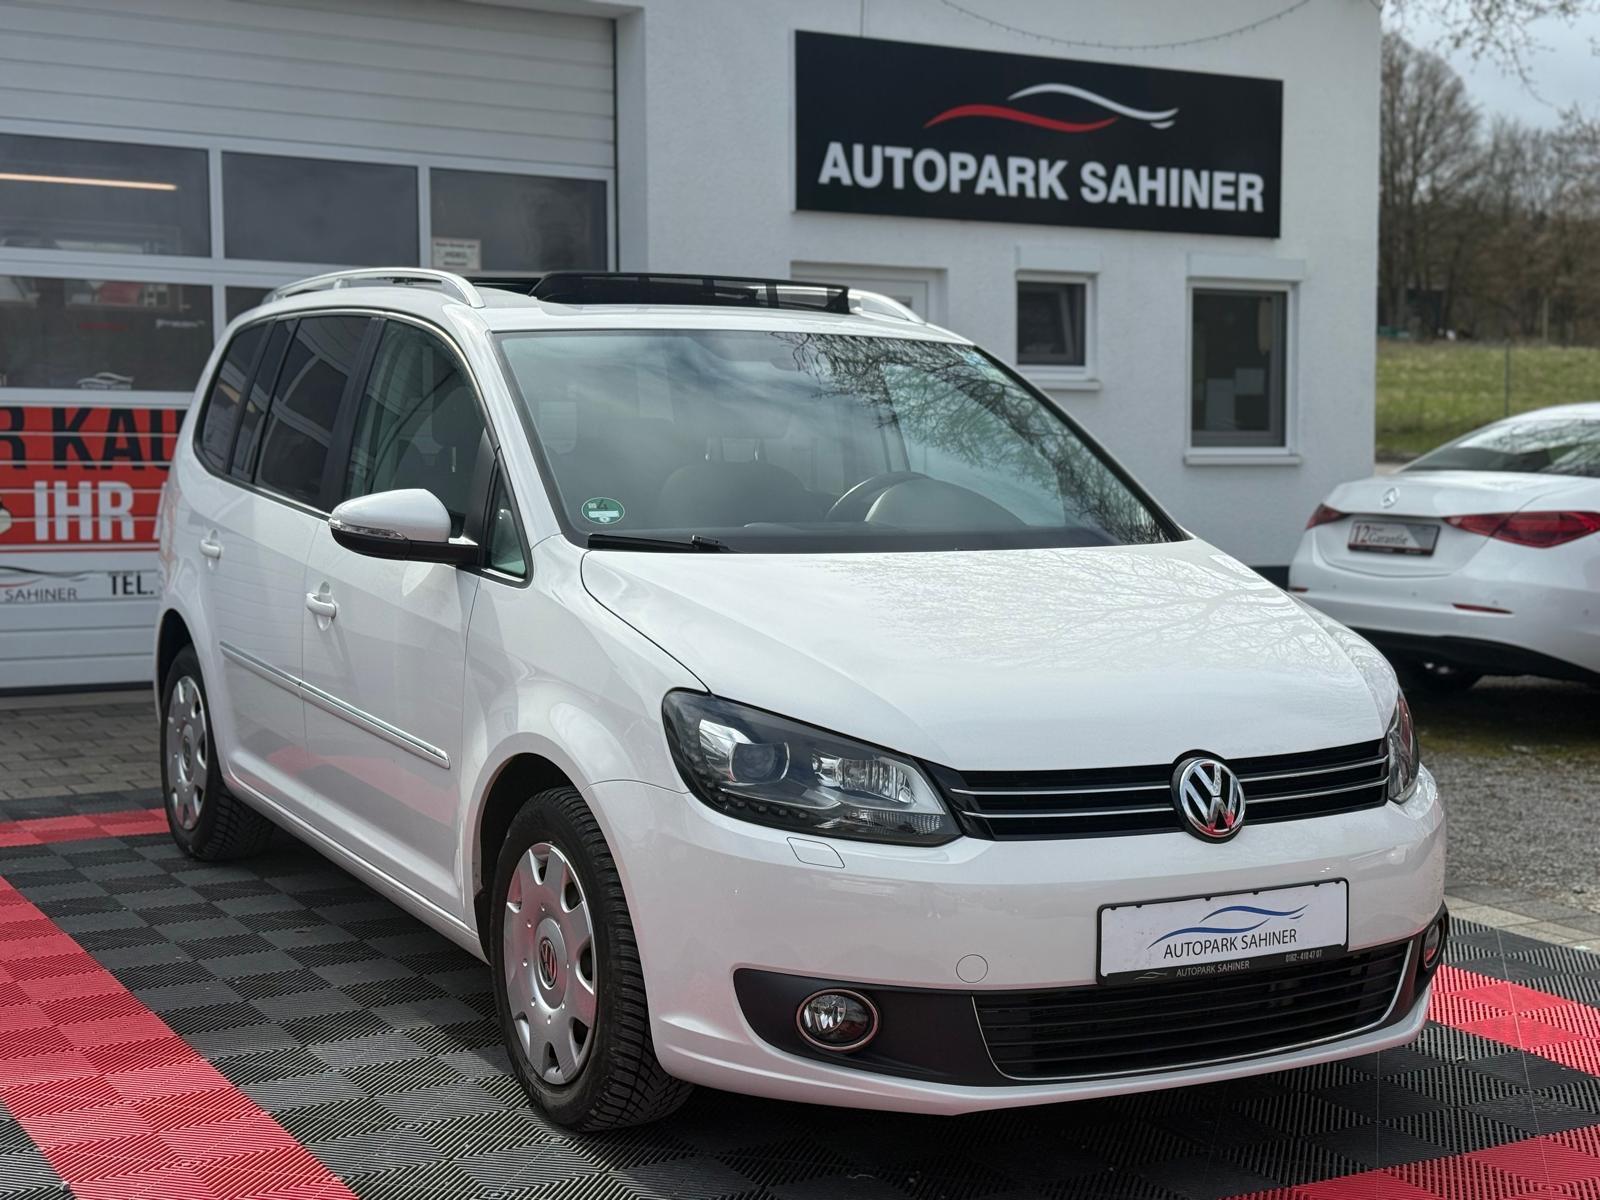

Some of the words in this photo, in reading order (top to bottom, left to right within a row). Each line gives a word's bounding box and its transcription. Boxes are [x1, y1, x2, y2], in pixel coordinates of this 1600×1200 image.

[818, 142, 1069, 202] AUTOPARK
[1080, 164, 1265, 213] SAHINER
[34, 480, 135, 541] IHR
[4, 588, 78, 601] SAHINER
[108, 571, 155, 596] TEL.
[1163, 935, 1238, 960] AUTOPARK
[1241, 928, 1298, 950] SAHINER
[1176, 965, 1216, 978] AUTOPARK
[1217, 960, 1250, 973] SAHINER
